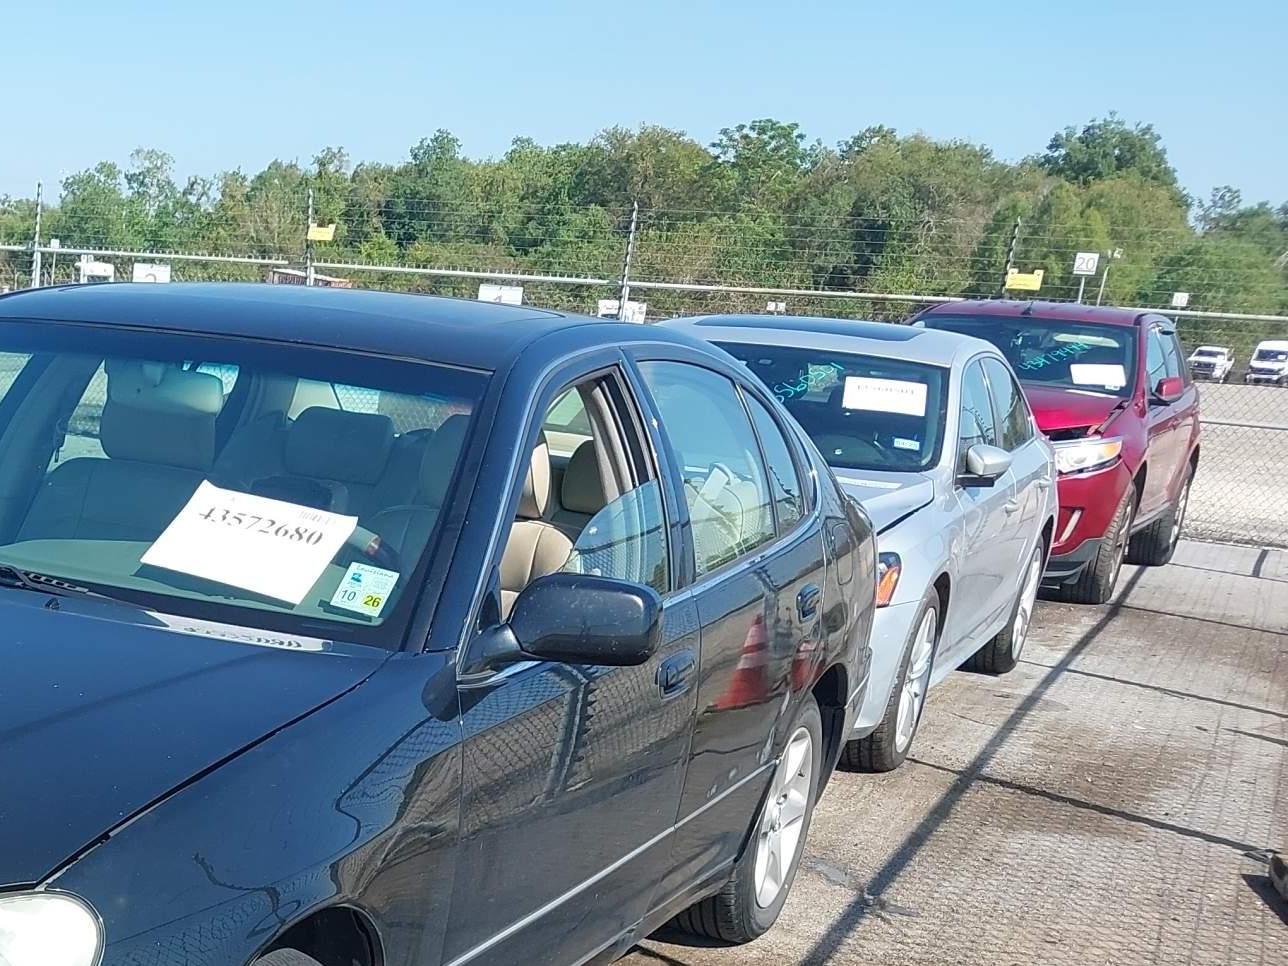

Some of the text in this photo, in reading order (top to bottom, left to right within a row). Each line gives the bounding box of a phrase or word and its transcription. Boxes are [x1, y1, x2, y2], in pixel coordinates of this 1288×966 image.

[1076, 256, 1096, 271] 20
[198, 506, 324, 546] 43572680
[341, 589, 357, 602] 10
[363, 594, 382, 608] 26
